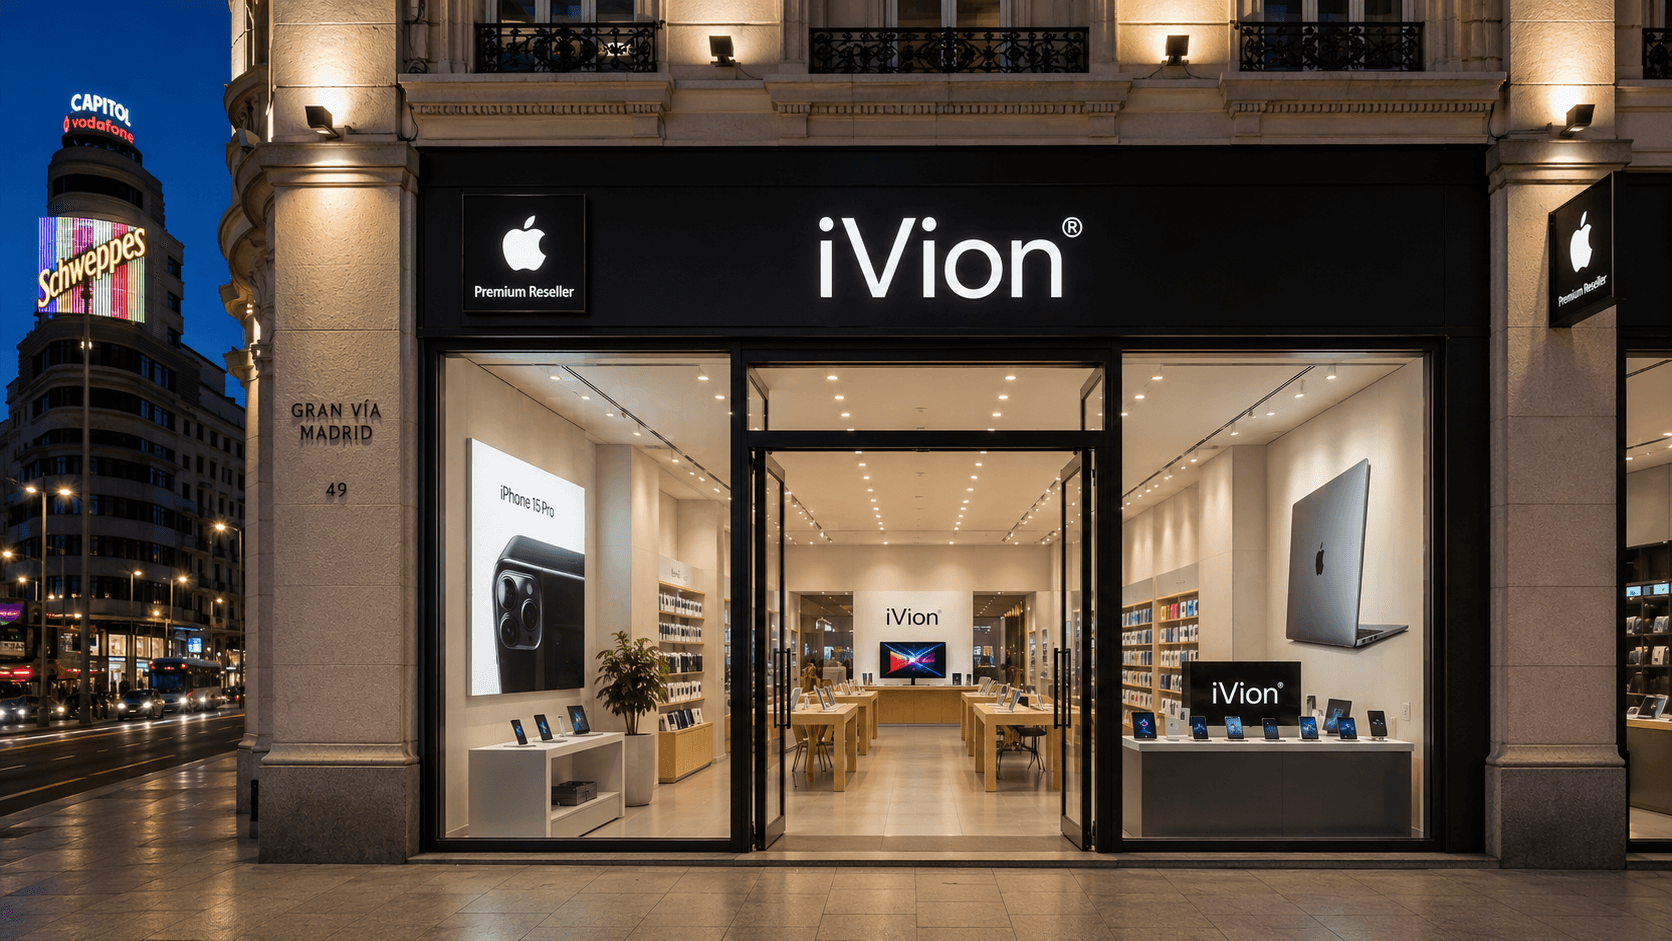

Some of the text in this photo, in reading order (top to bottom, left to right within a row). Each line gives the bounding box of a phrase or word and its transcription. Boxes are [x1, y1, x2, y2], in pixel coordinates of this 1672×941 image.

[71, 93, 131, 127] CAPITOL
[71, 116, 134, 144] vodafone
[38, 227, 146, 308] Schweppes
[474, 285, 575, 298] Premium Reseller
[1558, 274, 1607, 307] Premium Reseller
[290, 398, 382, 418] GRAN VÍA
[300, 425, 373, 441] MADRID
[325, 482, 348, 498] 49
[500, 484, 555, 518] iPhone 15 Pro
[886, 607, 942, 626] iVion
